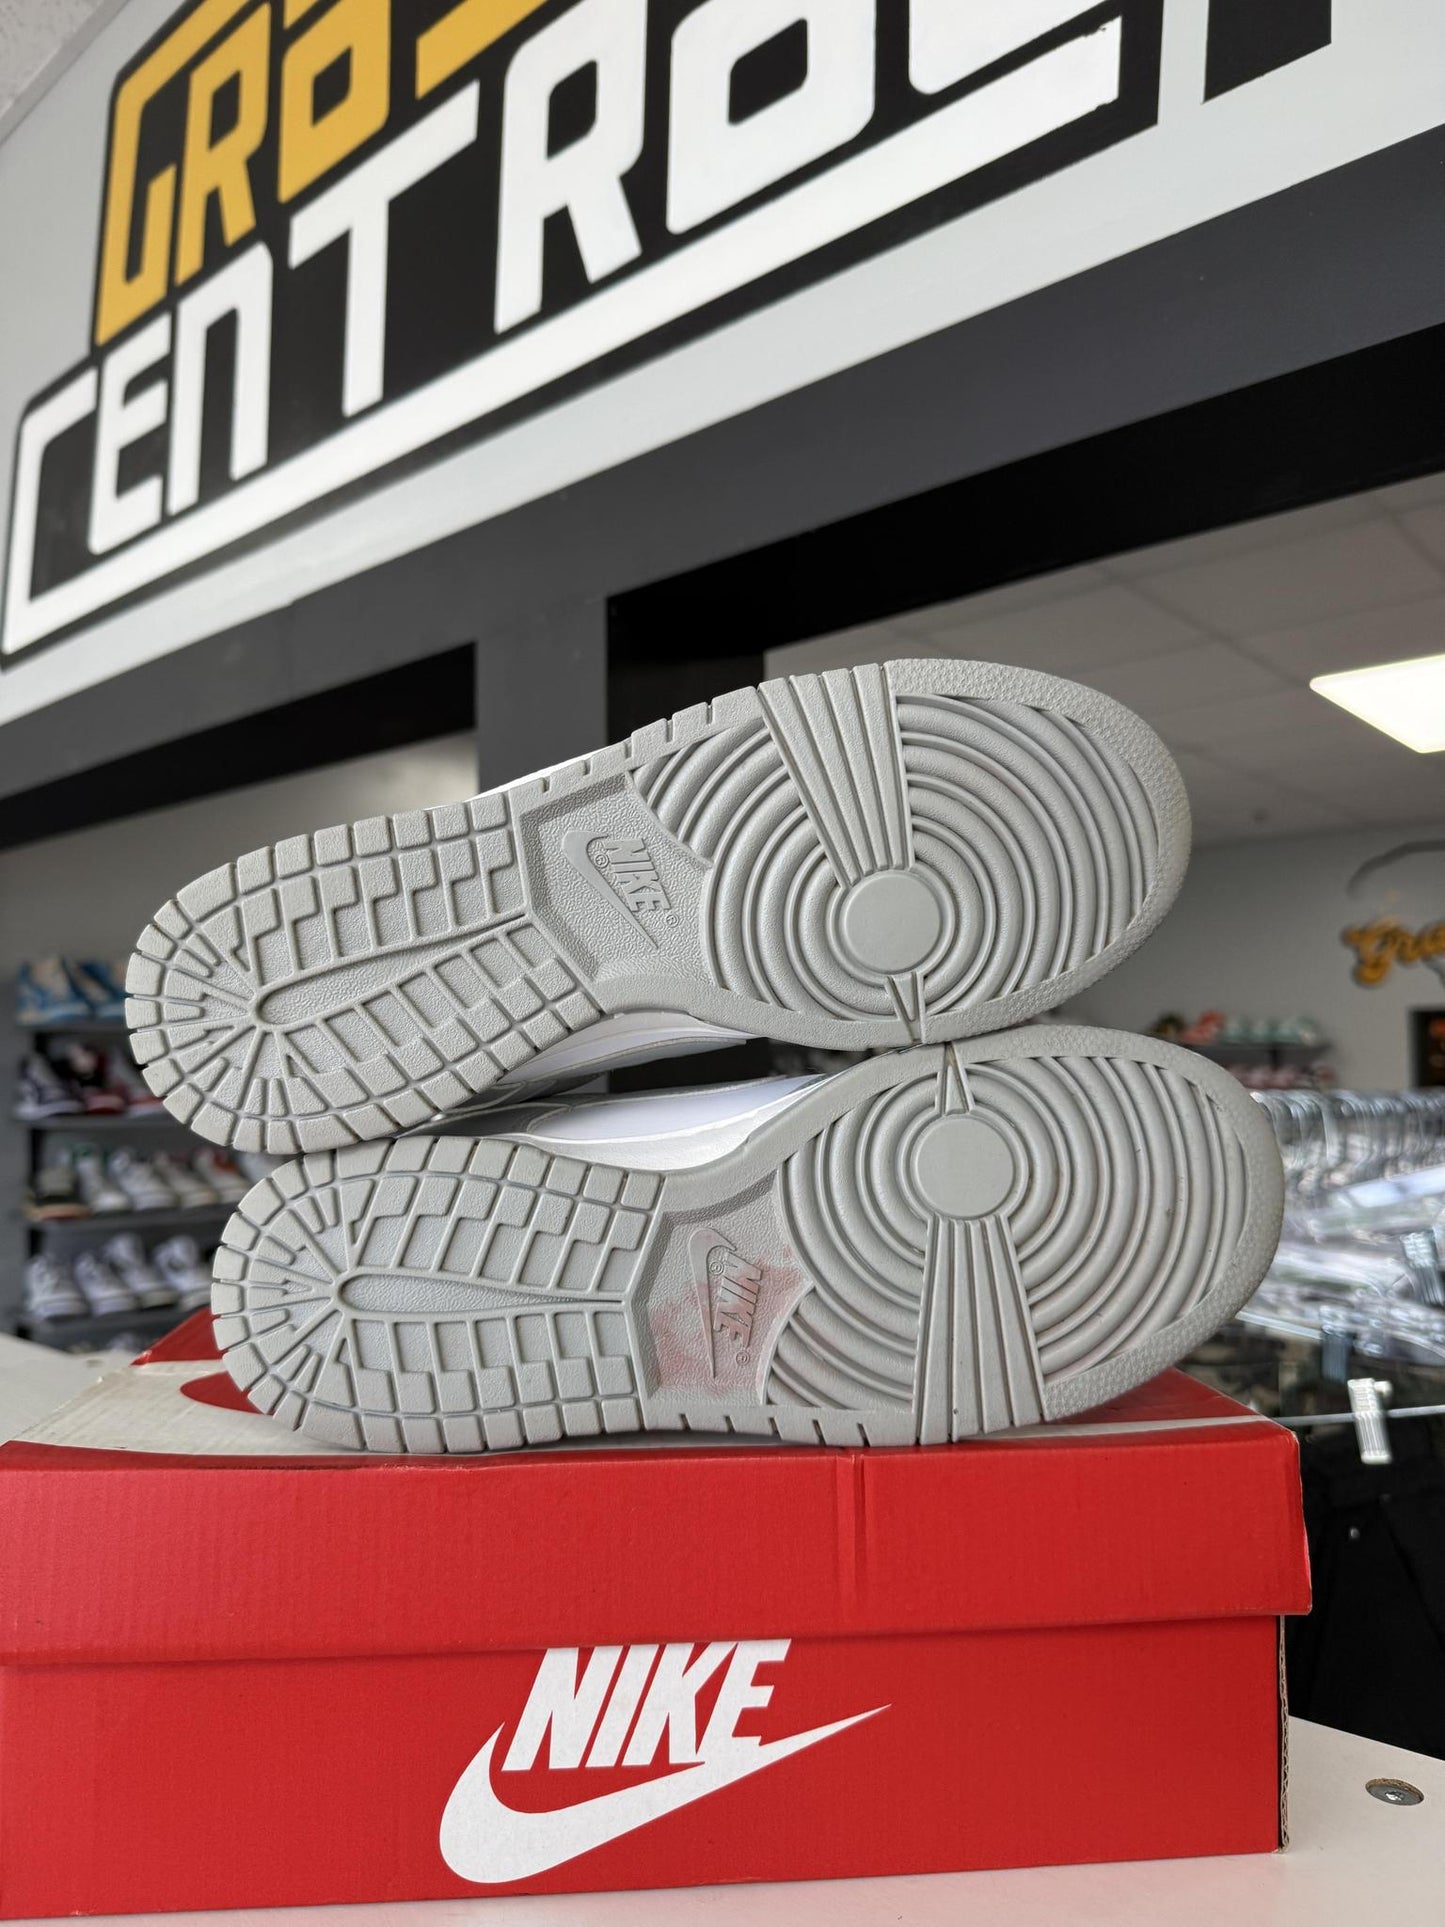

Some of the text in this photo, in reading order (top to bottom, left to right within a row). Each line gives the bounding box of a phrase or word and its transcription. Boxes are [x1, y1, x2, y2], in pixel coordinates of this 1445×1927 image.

[602, 838, 672, 913] NIKE
[713, 1251, 763, 1349] NIKE
[501, 1638, 791, 1771] NIKE
